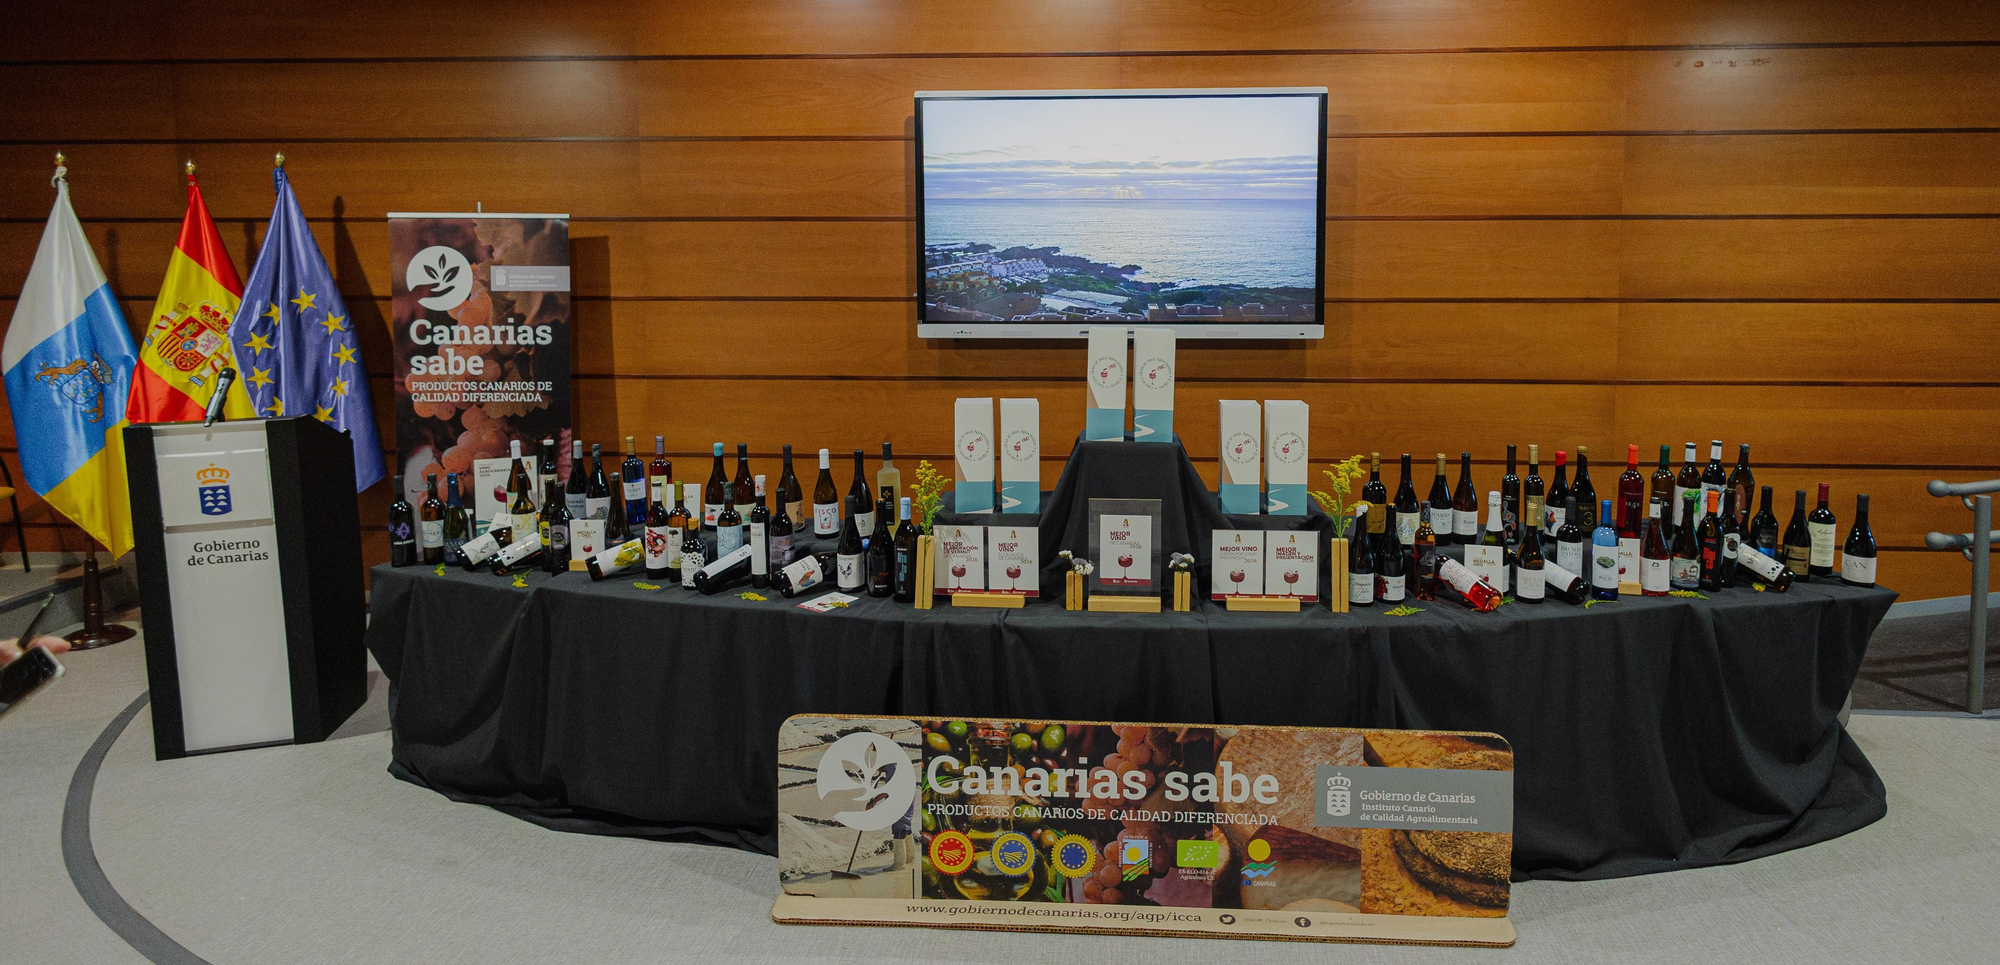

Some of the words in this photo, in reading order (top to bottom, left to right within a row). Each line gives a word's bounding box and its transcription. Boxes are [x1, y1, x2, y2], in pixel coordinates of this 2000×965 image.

[409, 317, 553, 345] Canarias
[410, 348, 484, 375] sabe
[411, 381, 477, 391] PRODUCTOS
[479, 381, 535, 391] CANARIOS
[537, 381, 553, 391] DE
[411, 393, 460, 402] CALIDAD
[462, 393, 542, 402] DIFERENCIADA
[815, 507, 836, 515] FISCO
[1583, 512, 1593, 526] 3
[194, 540, 260, 552] Gobierno
[187, 555, 204, 566] de
[207, 551, 269, 564] Canarias
[1845, 560, 1867, 569] CAN
[927, 754, 1147, 800] Canarias
[1164, 761, 1279, 804] sabe
[1360, 790, 1411, 802] Gobierno
[1413, 791, 1427, 802] de
[1428, 792, 1476, 804] Canarias
[927, 803, 1009, 816] PRODUCTOS
[1013, 806, 1084, 819] CANARIOS
[1088, 808, 1105, 820] DE
[1110, 809, 1171, 822] CALIDAD
[1174, 812, 1278, 826] DIFERENCIADA
[1362, 803, 1400, 812] Instituto
[1402, 804, 1436, 813] Canario
[1360, 813, 1370, 821] de
[1372, 813, 1404, 822] Calidad
[1406, 814, 1478, 824] Agroalimentaria
[906, 904, 1202, 922] www.gobiernodecanarias.org/agp/icca
